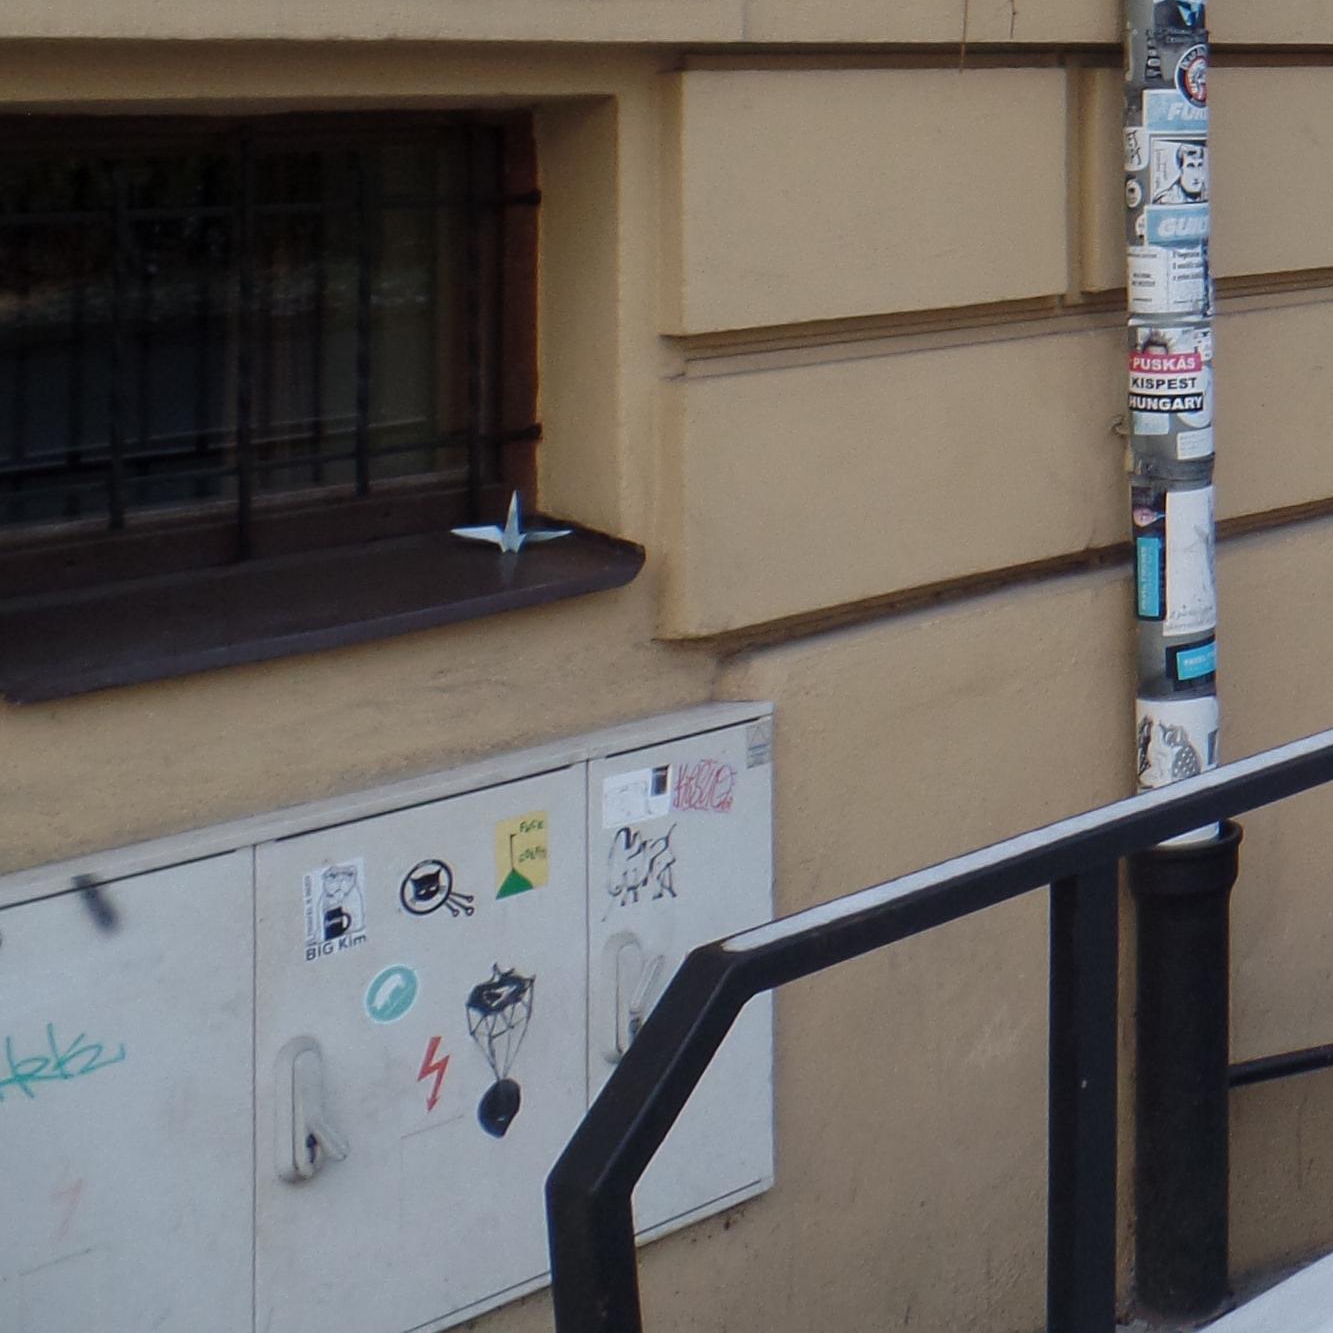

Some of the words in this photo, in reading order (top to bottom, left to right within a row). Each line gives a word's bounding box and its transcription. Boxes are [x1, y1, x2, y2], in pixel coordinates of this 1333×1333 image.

[1133, 357, 1197, 373] PUSKÁS
[1131, 376, 1198, 391] KISPEST
[1129, 395, 1203, 411] HUNGARY
[305, 943, 335, 962] BIG
[338, 932, 368, 951] Kim
